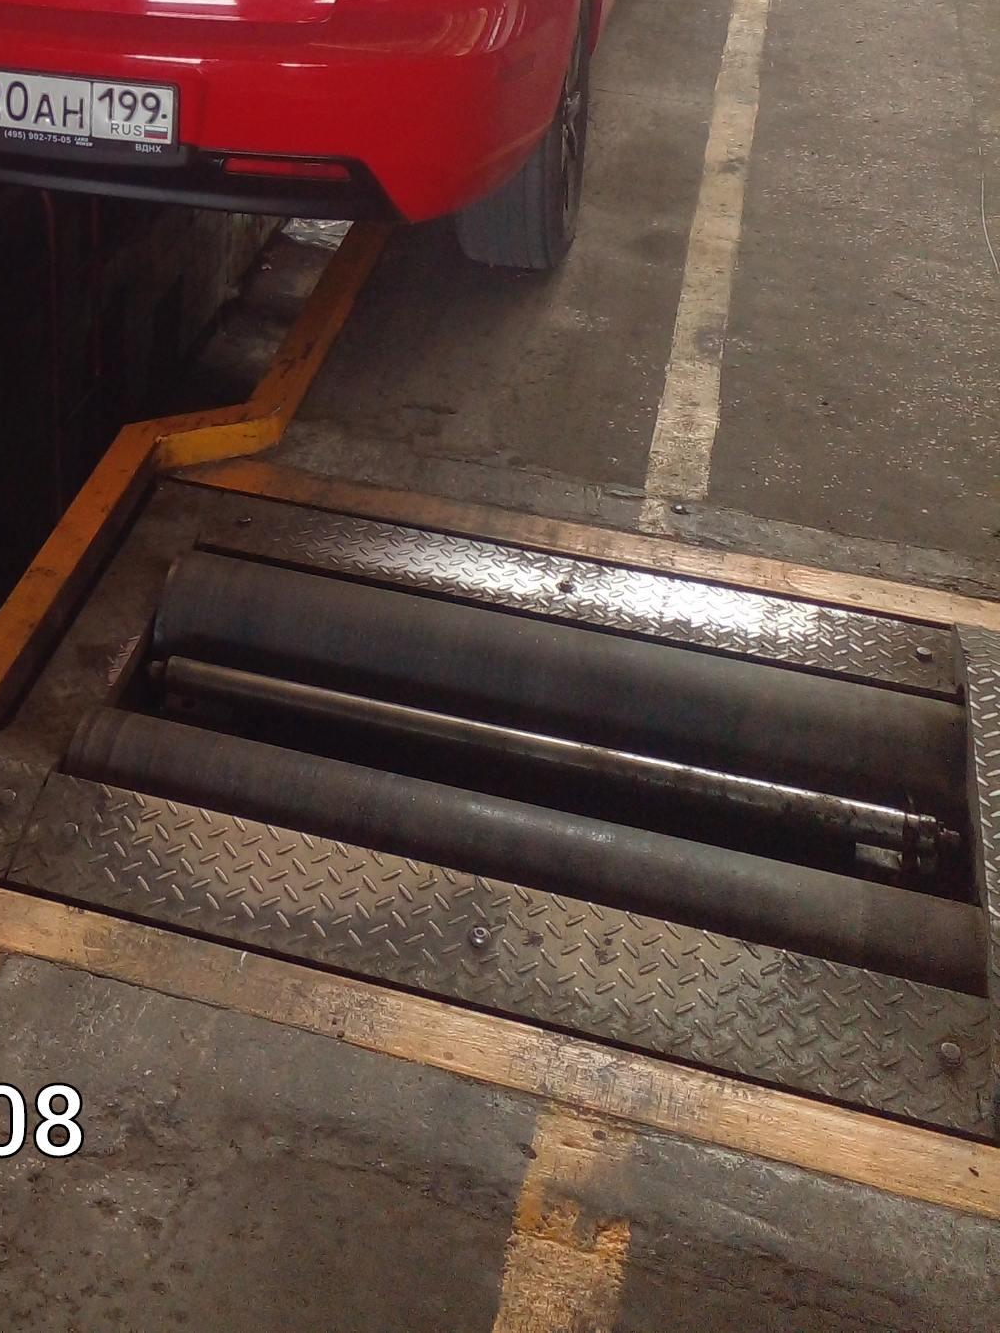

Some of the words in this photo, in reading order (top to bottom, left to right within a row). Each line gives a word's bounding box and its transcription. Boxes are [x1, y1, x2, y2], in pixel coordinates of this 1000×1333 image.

[98, 87, 160, 125] 199
[4, 129, 26, 140] (495)
[110, 123, 143, 137] RUS
[135, 143, 162, 153] ВДНХ
